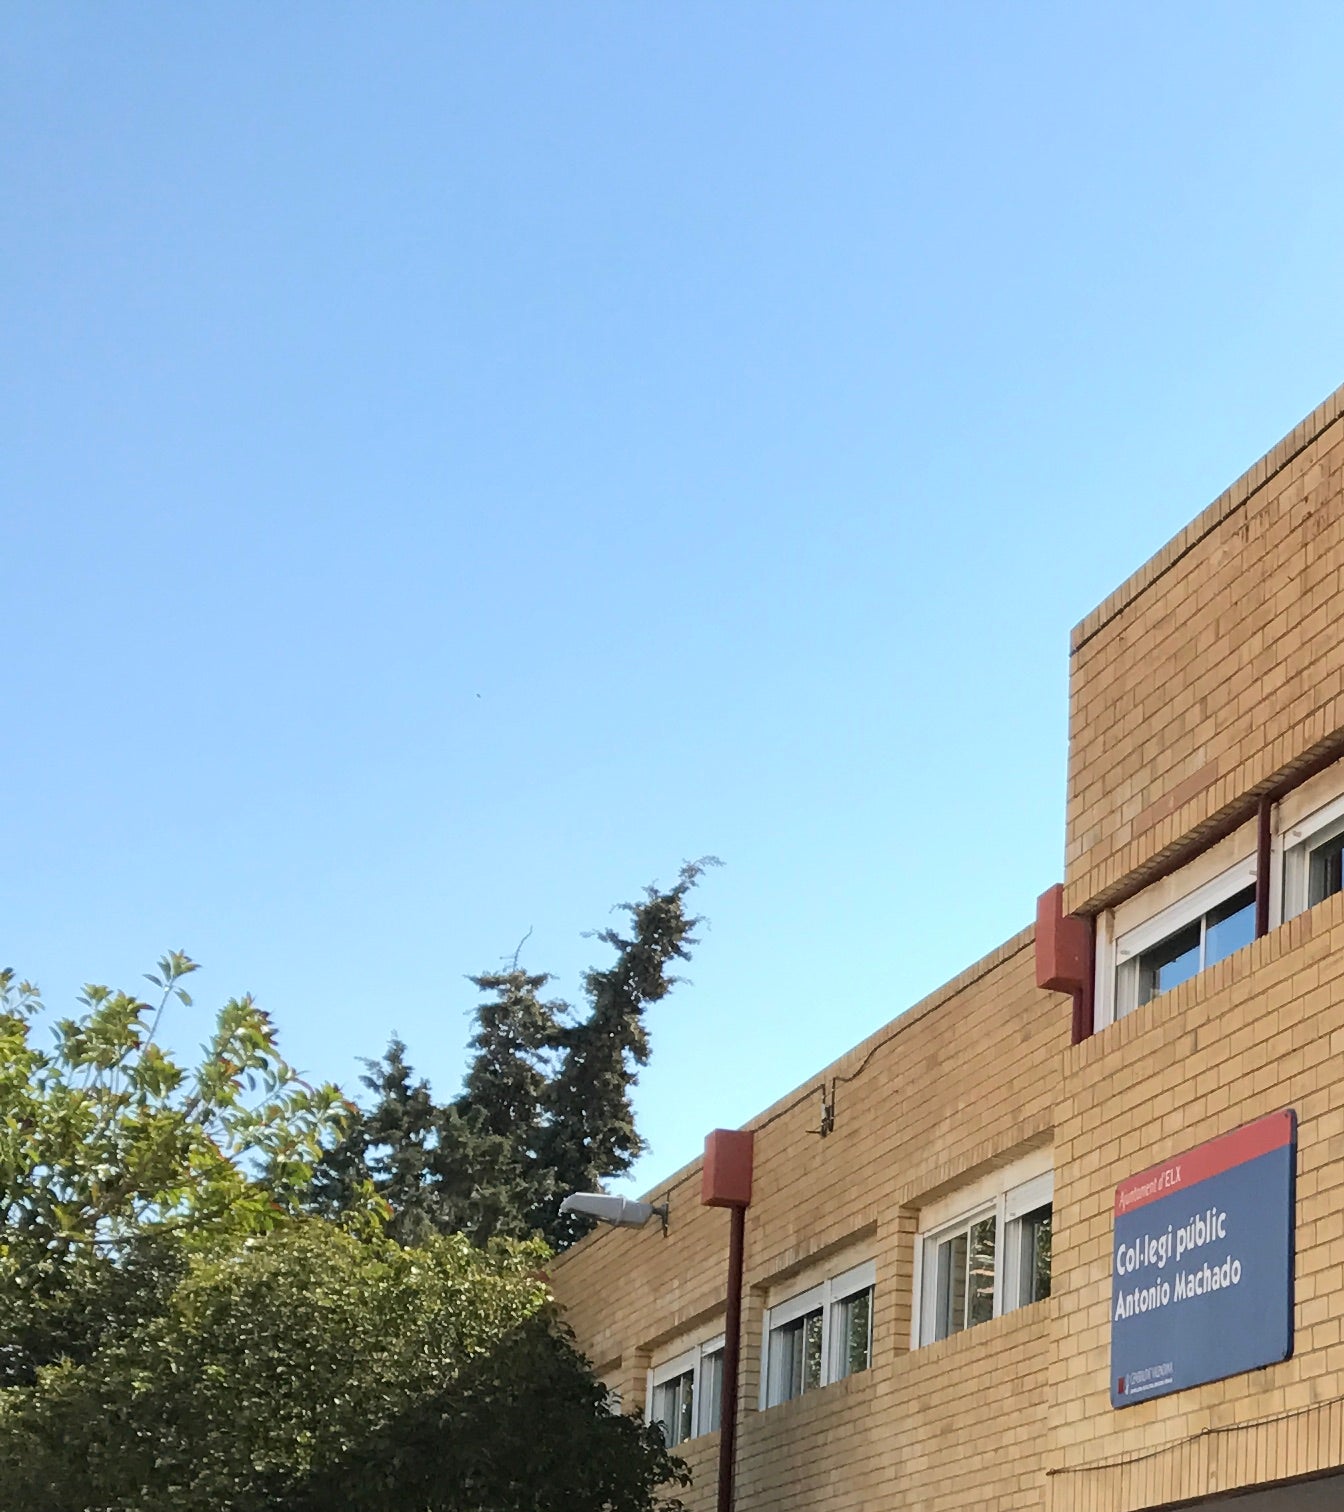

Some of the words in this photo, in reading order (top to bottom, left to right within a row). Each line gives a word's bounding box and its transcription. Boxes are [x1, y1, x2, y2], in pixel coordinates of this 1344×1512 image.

[1119, 1177, 1157, 1211] Ajuntament
[1158, 1165, 1182, 1191] d'ELX
[1117, 1224, 1172, 1276] Col·legi
[1176, 1206, 1227, 1261] públic
[1114, 1277, 1170, 1321] Antonio
[1174, 1255, 1241, 1302] Machado
